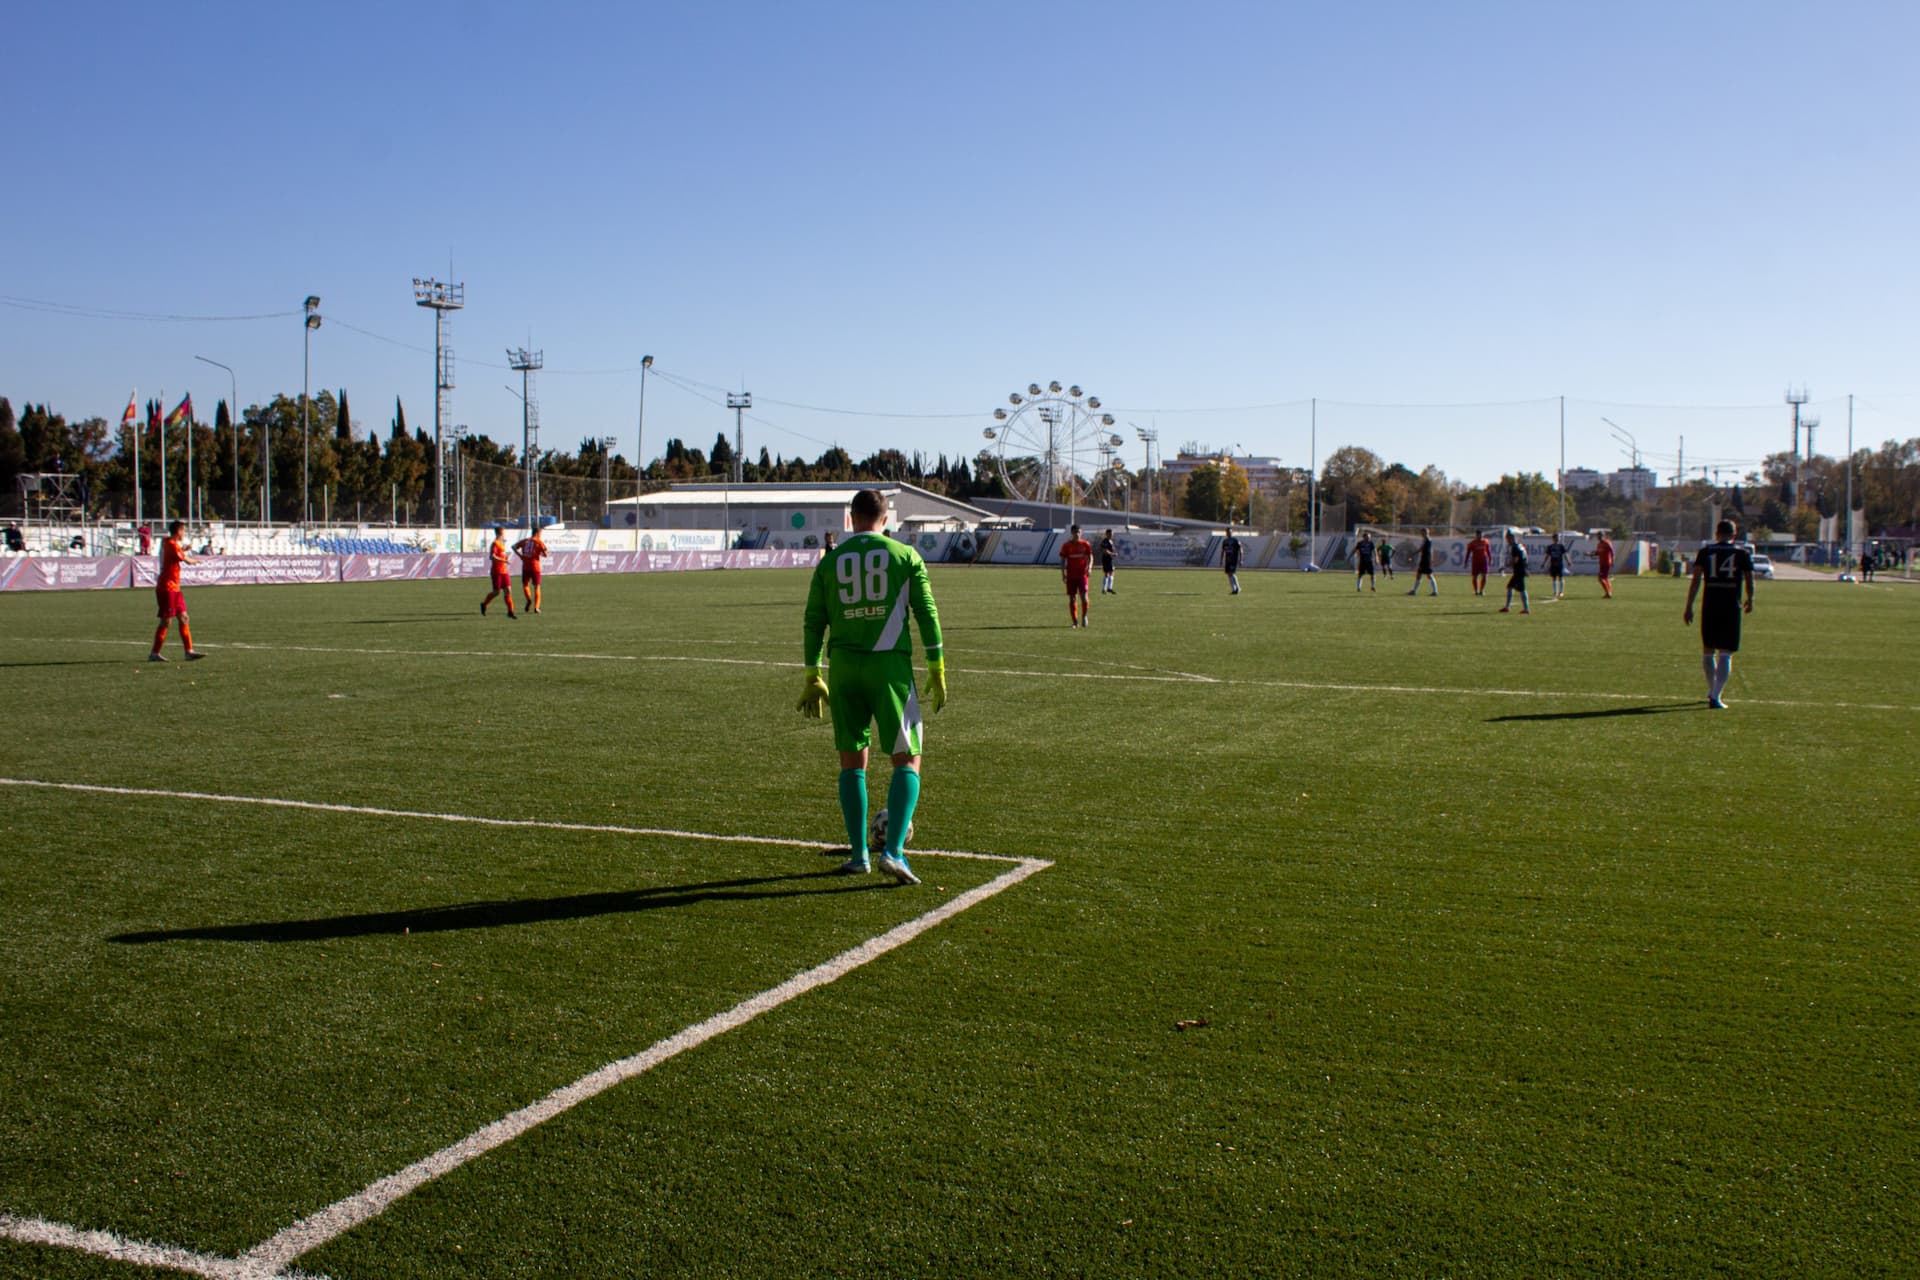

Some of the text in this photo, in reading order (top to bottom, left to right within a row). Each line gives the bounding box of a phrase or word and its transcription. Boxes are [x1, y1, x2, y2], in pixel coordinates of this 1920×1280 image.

[836, 548, 889, 604] 98
[1709, 552, 1737, 578] 14
[843, 605, 887, 619] SEUS
